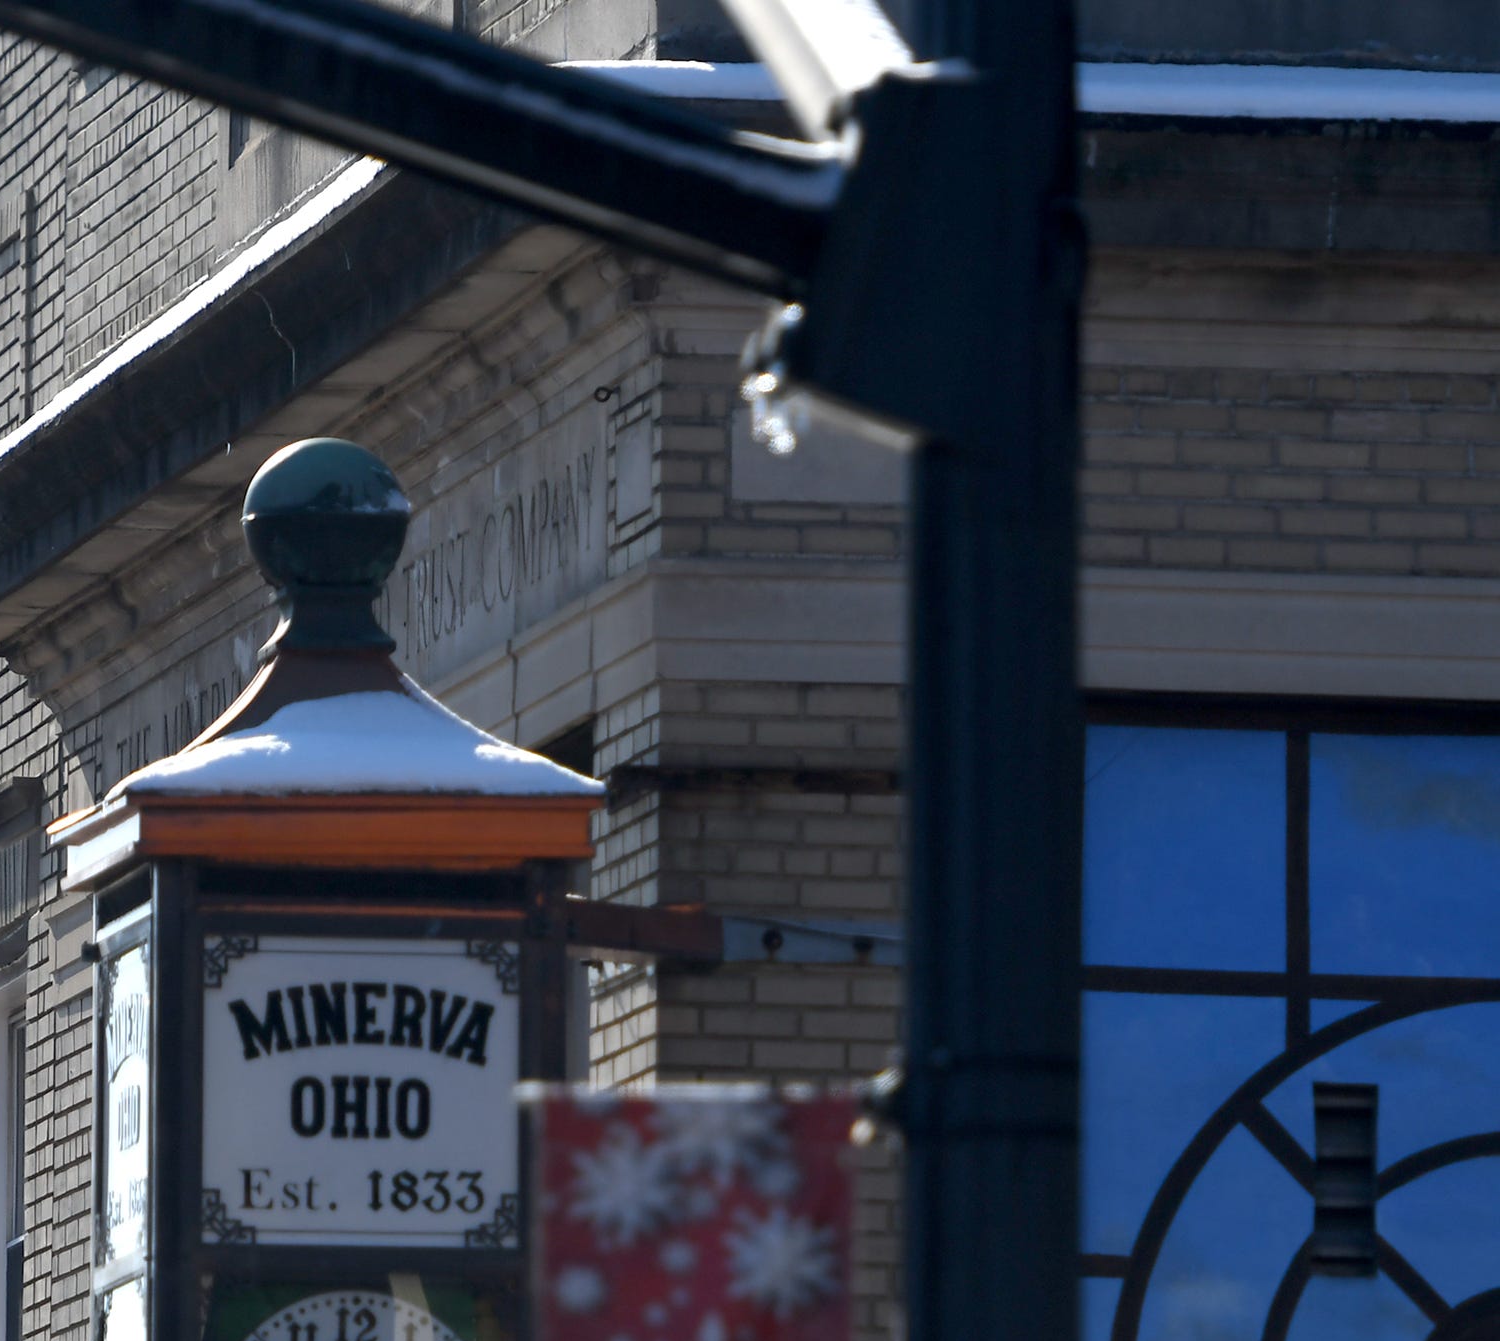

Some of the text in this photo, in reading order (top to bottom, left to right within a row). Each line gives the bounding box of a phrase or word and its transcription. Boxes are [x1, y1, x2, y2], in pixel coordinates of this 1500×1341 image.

[403, 529, 469, 660] TRUST
[481, 446, 595, 614] COMPANY
[228, 982, 495, 1067] MINERVA
[290, 1075, 431, 1140] OHIO
[238, 1167, 485, 1214] Est. 1833
